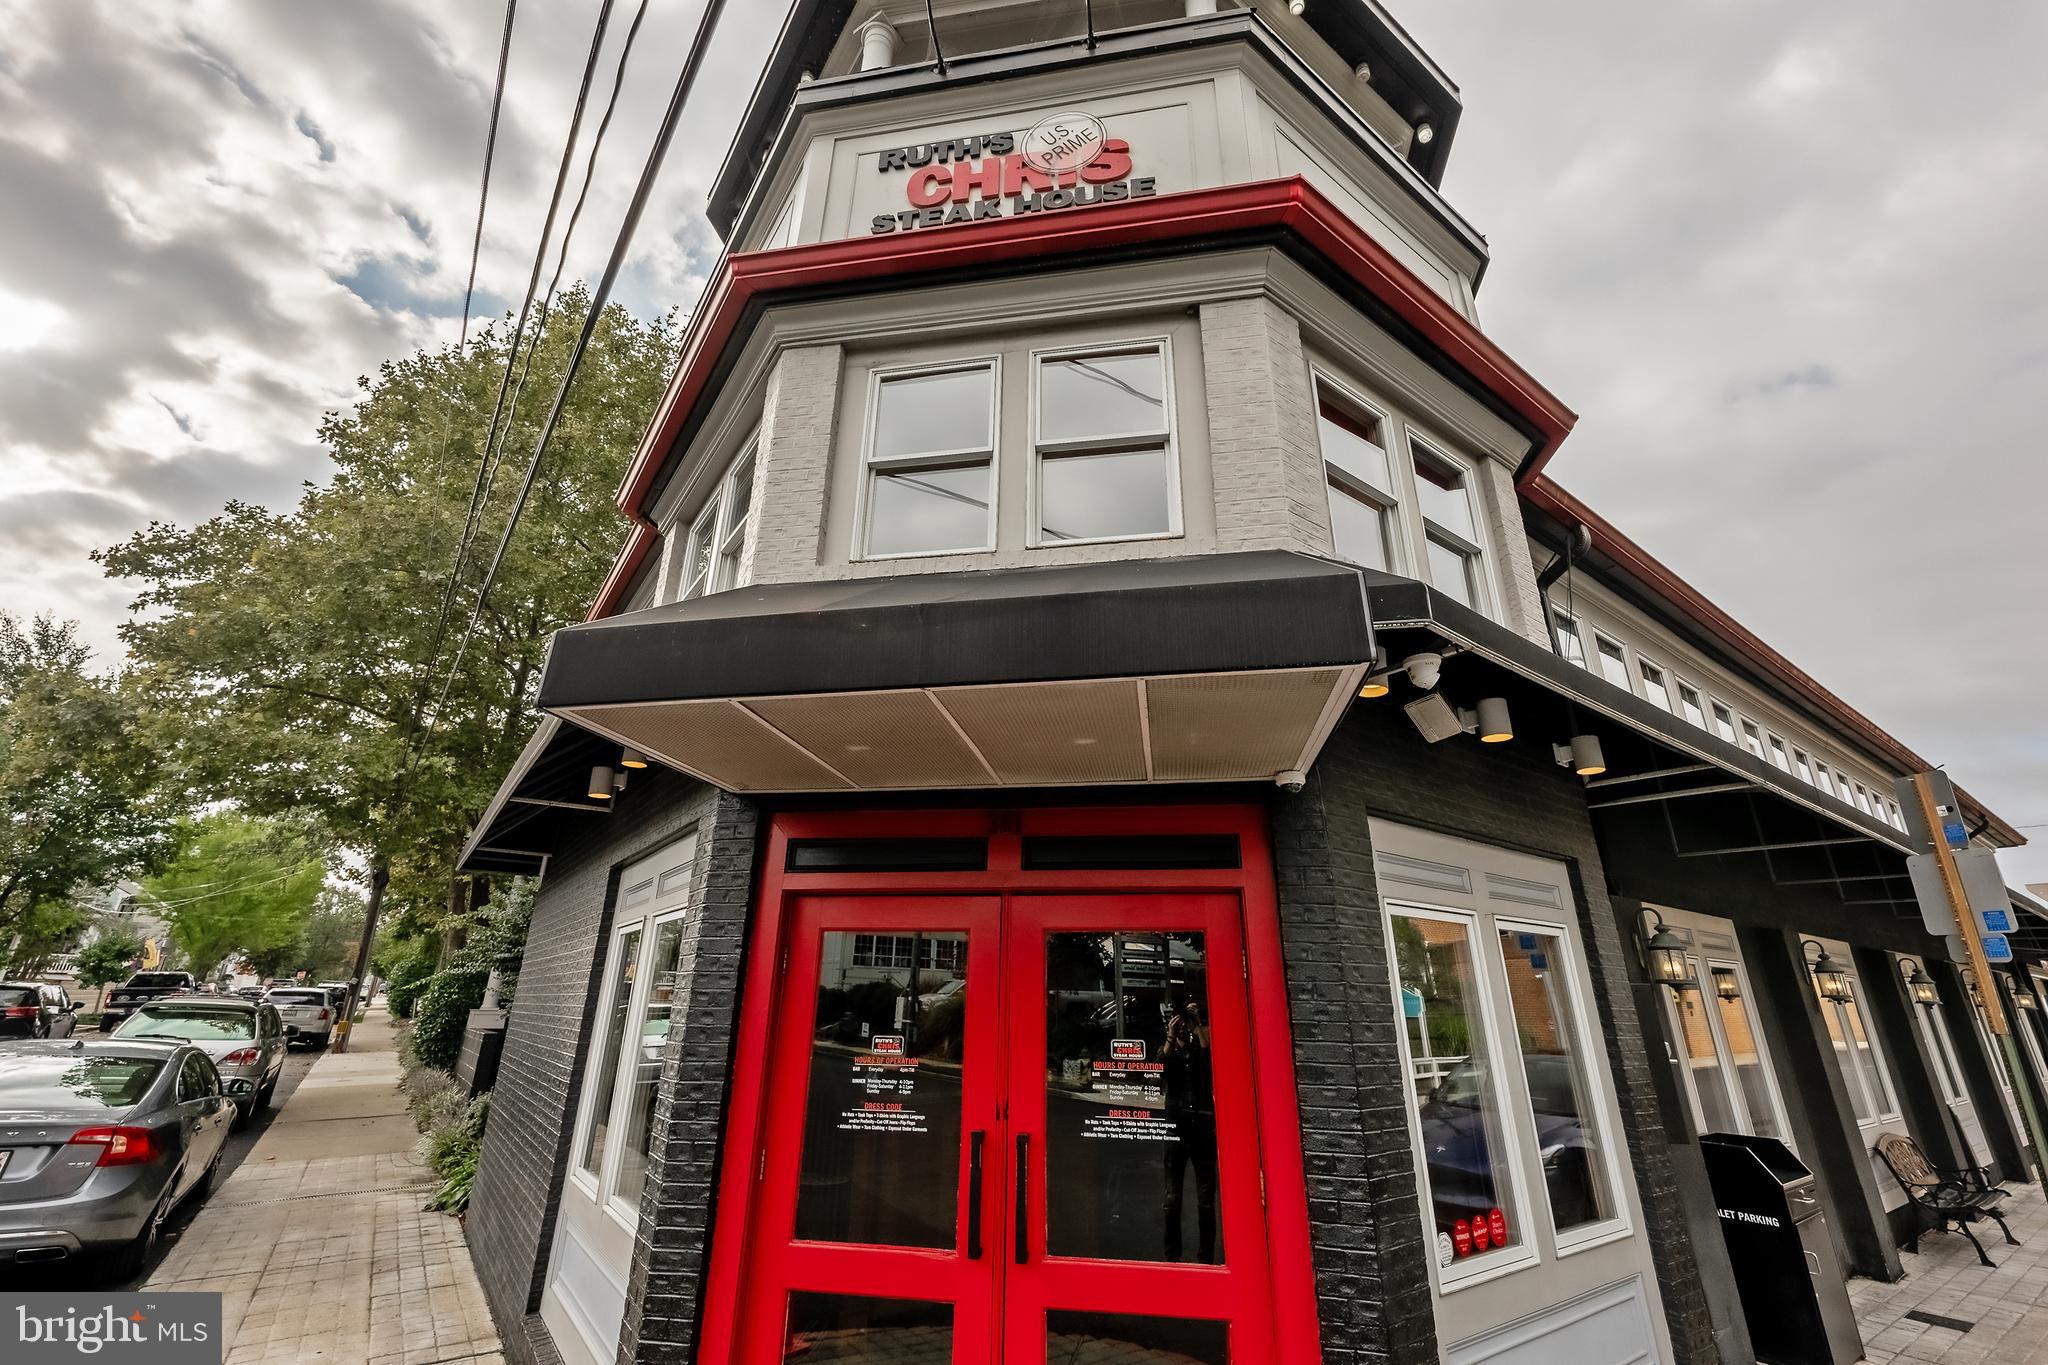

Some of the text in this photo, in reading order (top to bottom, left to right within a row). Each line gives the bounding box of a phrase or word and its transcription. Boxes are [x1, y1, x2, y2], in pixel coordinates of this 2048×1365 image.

[1040, 124, 1074, 146] U.S.
[878, 132, 1014, 173] RUTH'S
[1041, 127, 1098, 167] PRIME
[870, 176, 1156, 235] STEAK HOUSE
[854, 1056, 874, 1064] HOURS
[885, 1057, 919, 1065] OPERATION
[1093, 1061, 1116, 1069] HOURS
[1127, 1062, 1164, 1071] OPERATION
[864, 1102, 884, 1110] DRESS
[1109, 1109, 1151, 1118] DRESS CODE
[1717, 1209, 1780, 1227] LET PARKING
